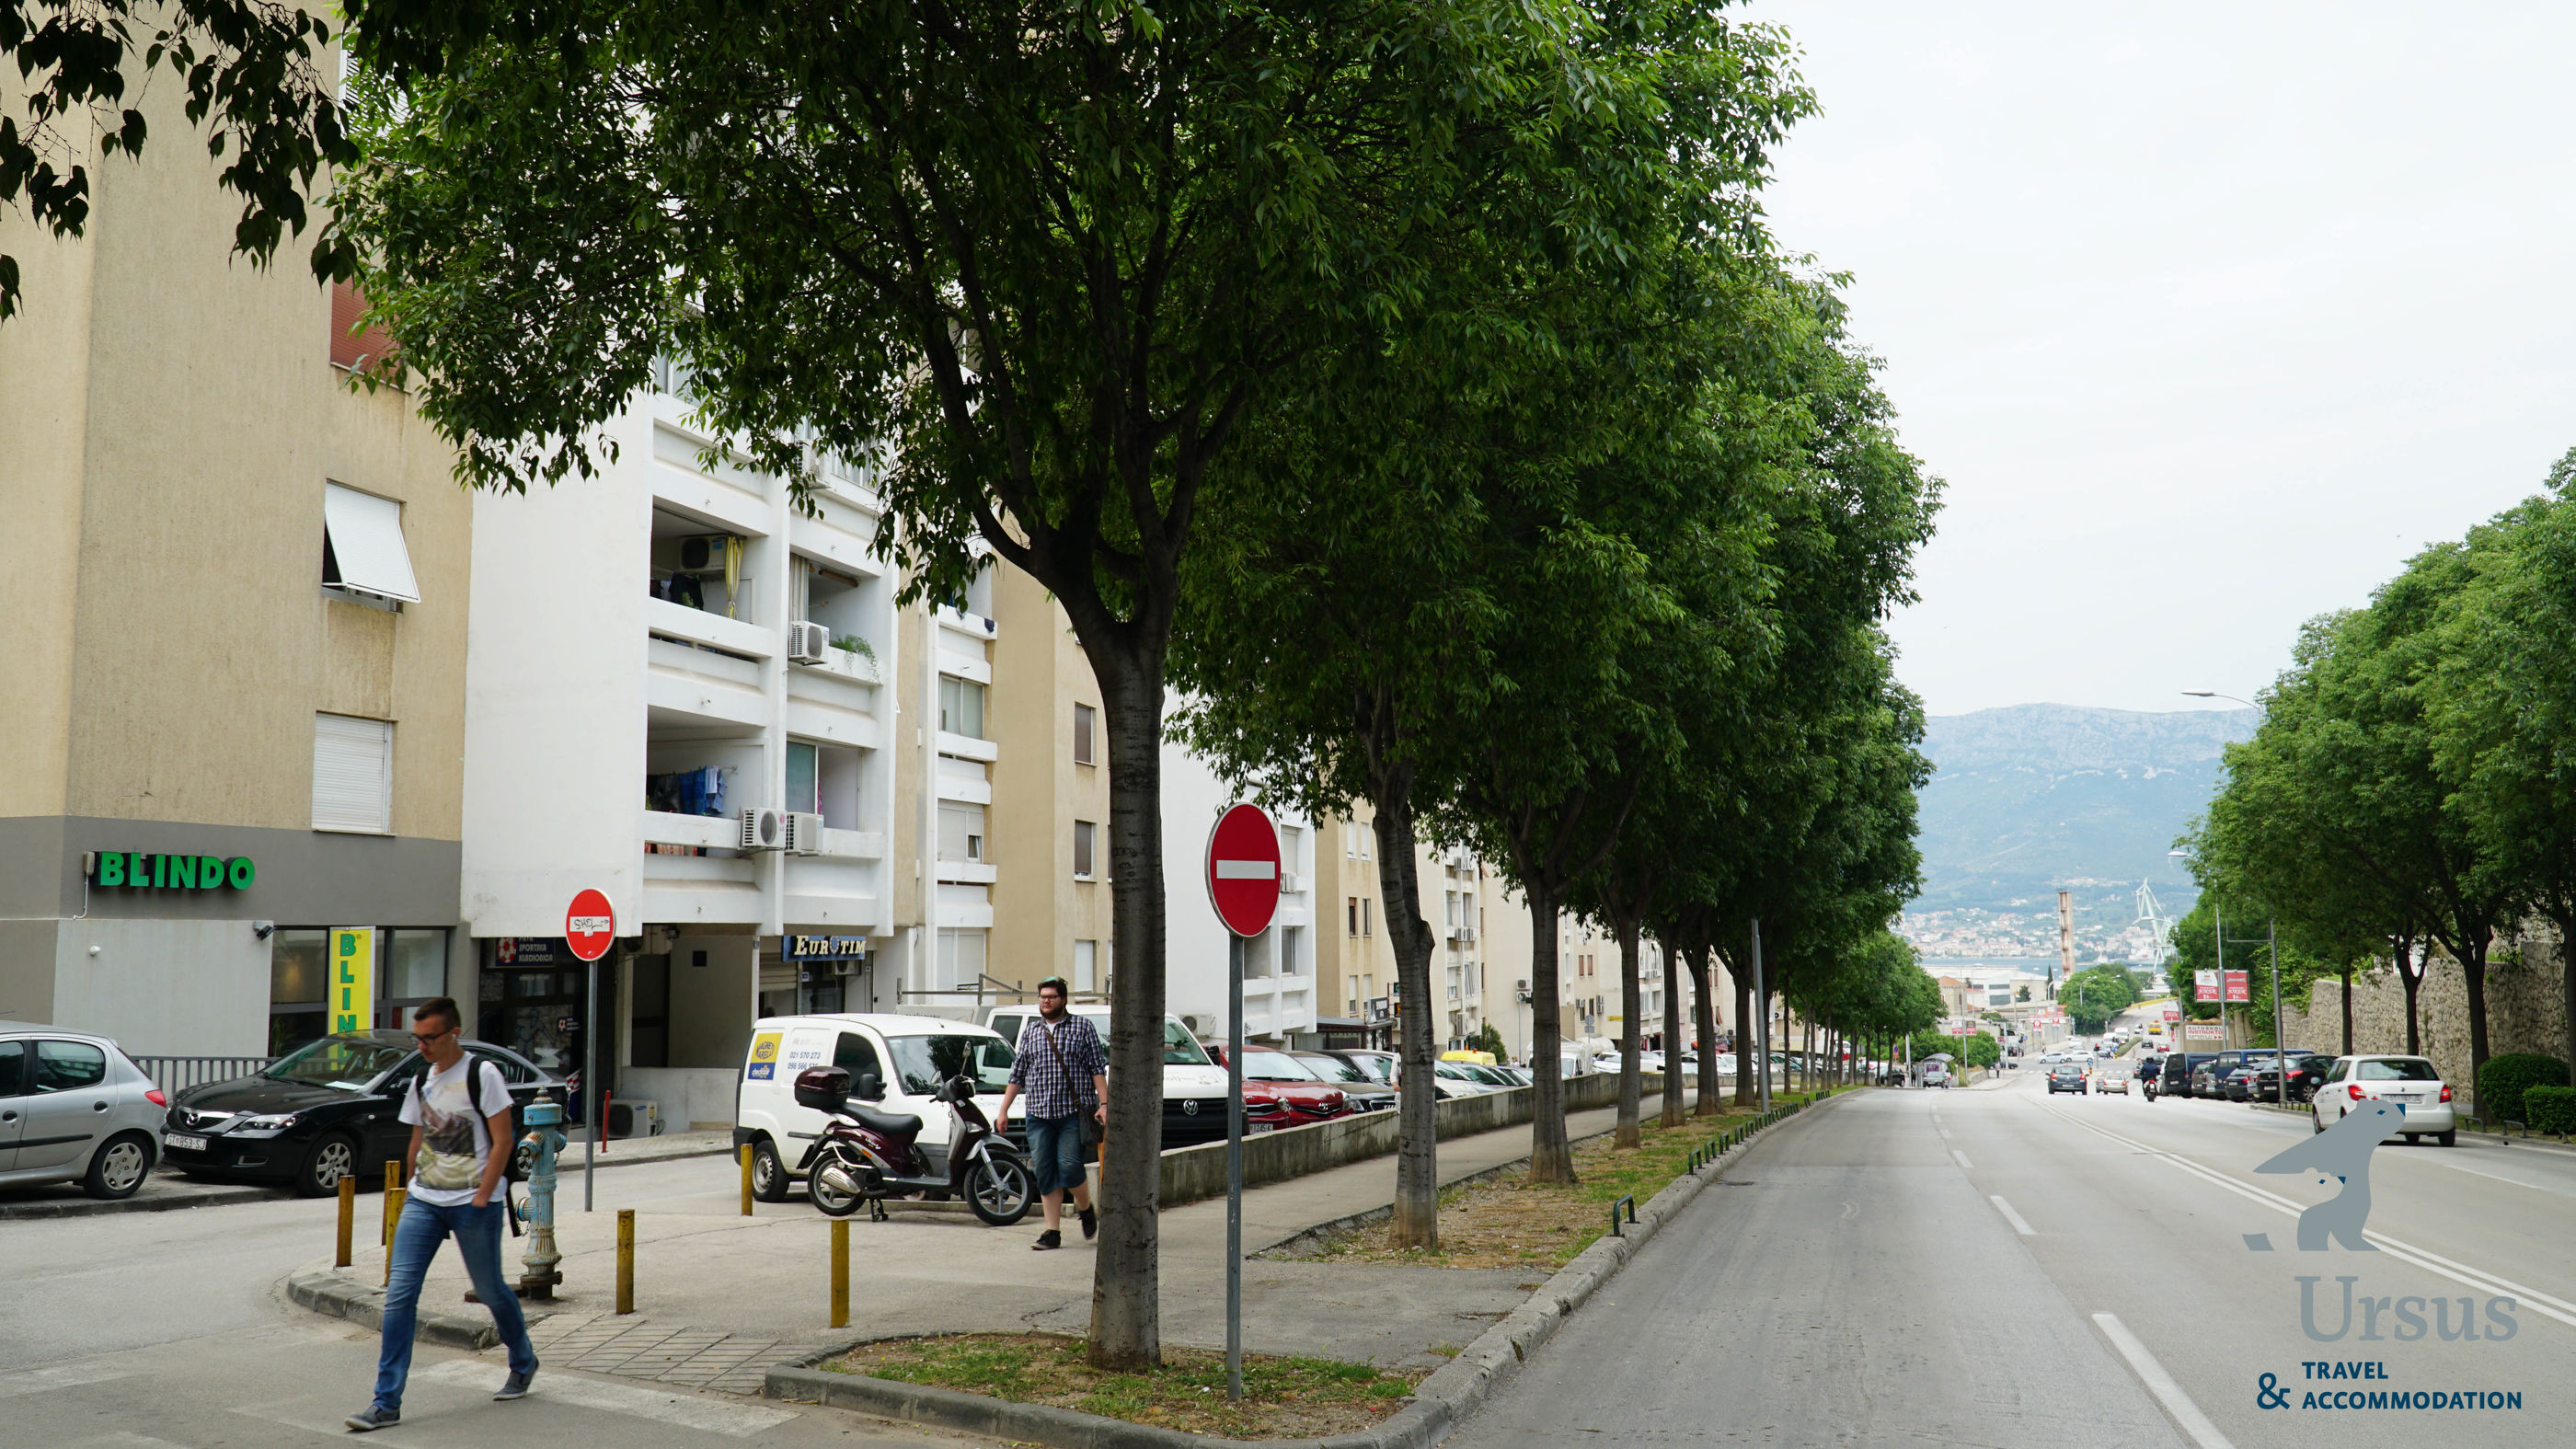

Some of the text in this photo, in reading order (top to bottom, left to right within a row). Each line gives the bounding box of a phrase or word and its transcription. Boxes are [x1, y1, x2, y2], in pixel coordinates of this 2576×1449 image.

[99, 852, 255, 890] BLINDO
[518, 943, 547, 951] SPORTSKA
[794, 935, 867, 955] EUROTIM
[518, 954, 553, 962] KLADIONICA
[168, 1134, 176, 1144] ST
